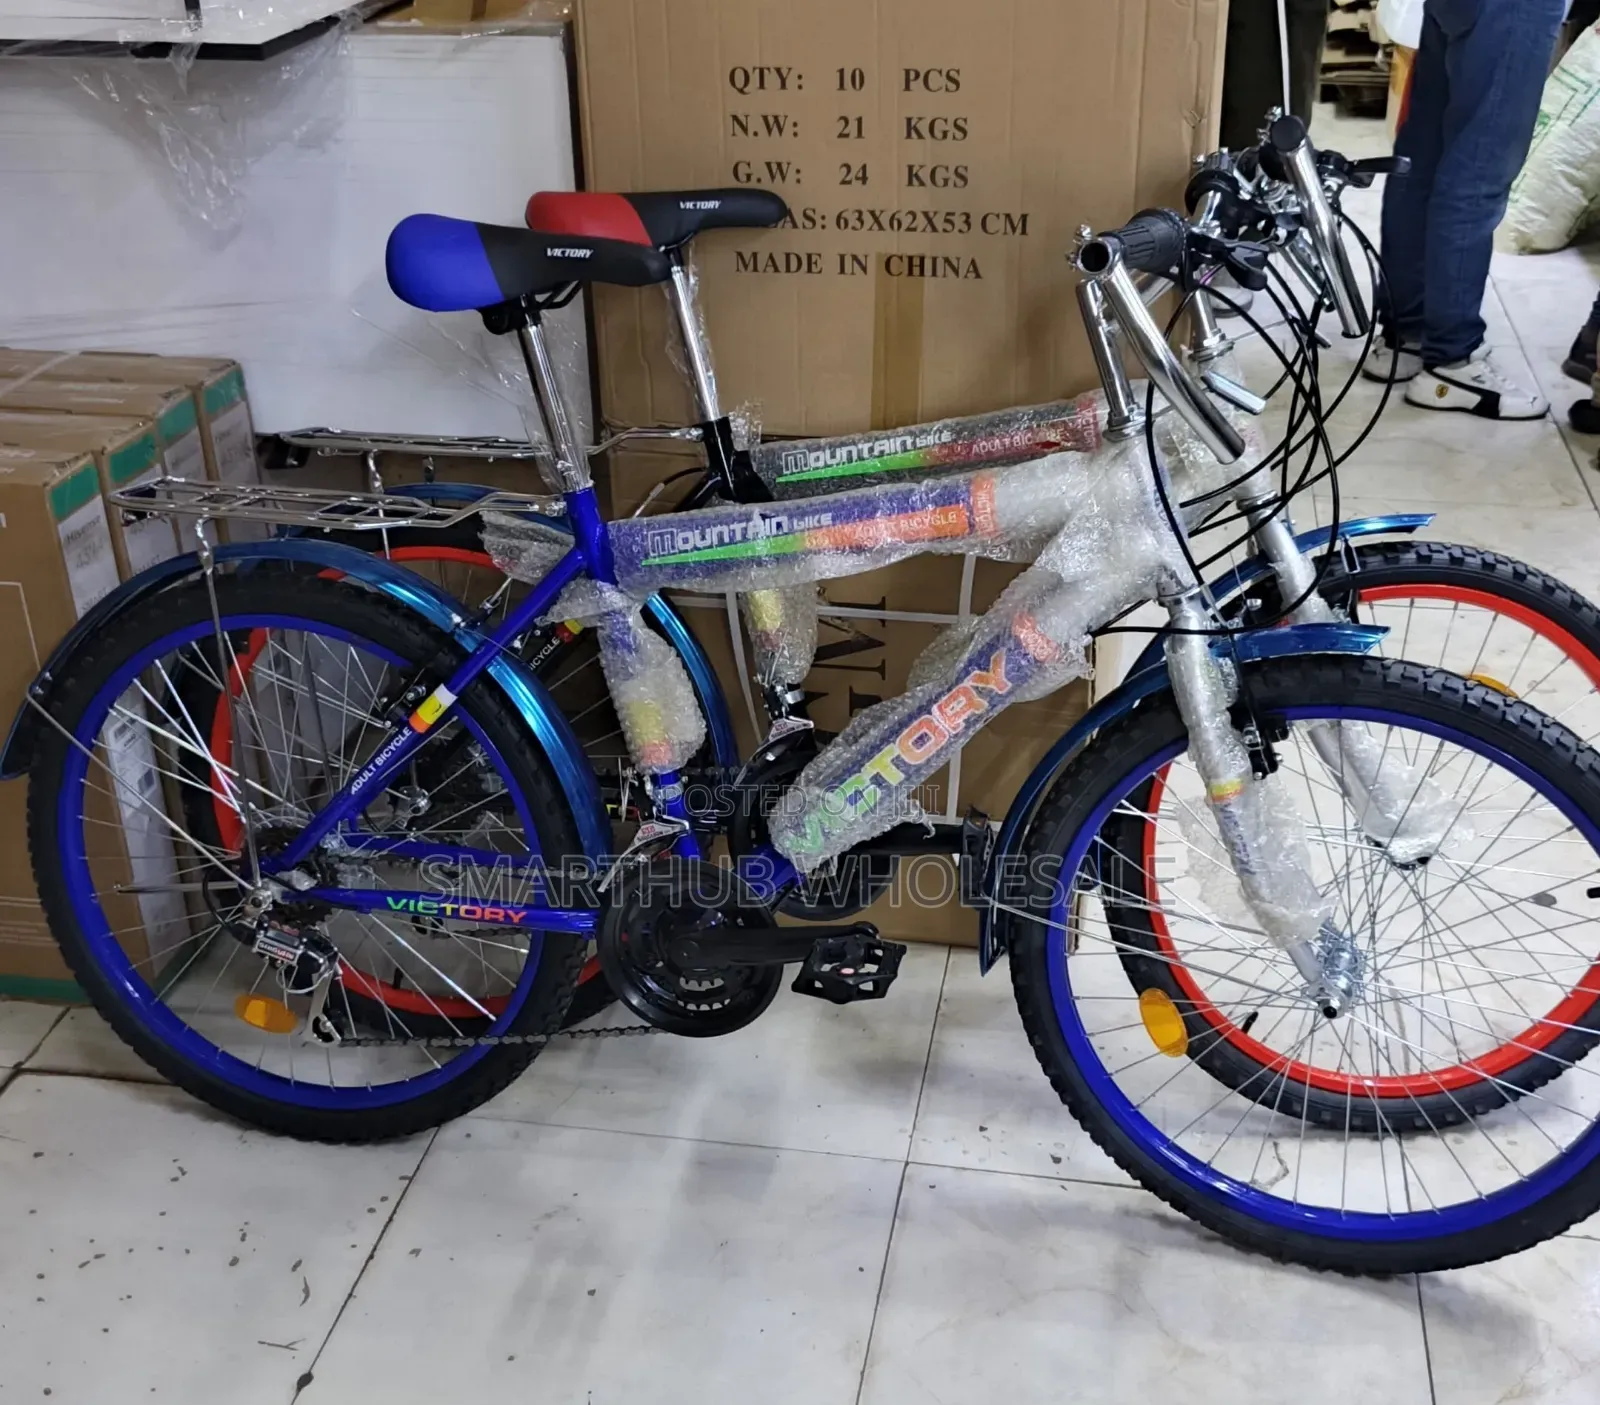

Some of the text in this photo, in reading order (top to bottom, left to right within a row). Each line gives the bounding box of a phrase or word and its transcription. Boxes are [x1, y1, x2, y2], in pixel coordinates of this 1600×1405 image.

[728, 66, 961, 95] QTY: 10 PCS
[730, 114, 968, 141] N.W: 21 KGS
[732, 161, 969, 188] G.W: 24 KGS
[680, 200, 722, 210] VICTORY
[835, 209, 972, 234] 63X62X53
[980, 212, 1029, 236] CM
[546, 248, 594, 259] VICTORY
[735, 251, 983, 280] MADE IN CHINA
[350, 726, 413, 796] ADULT BICYCLE
[386, 896, 528, 924] VICTORY
